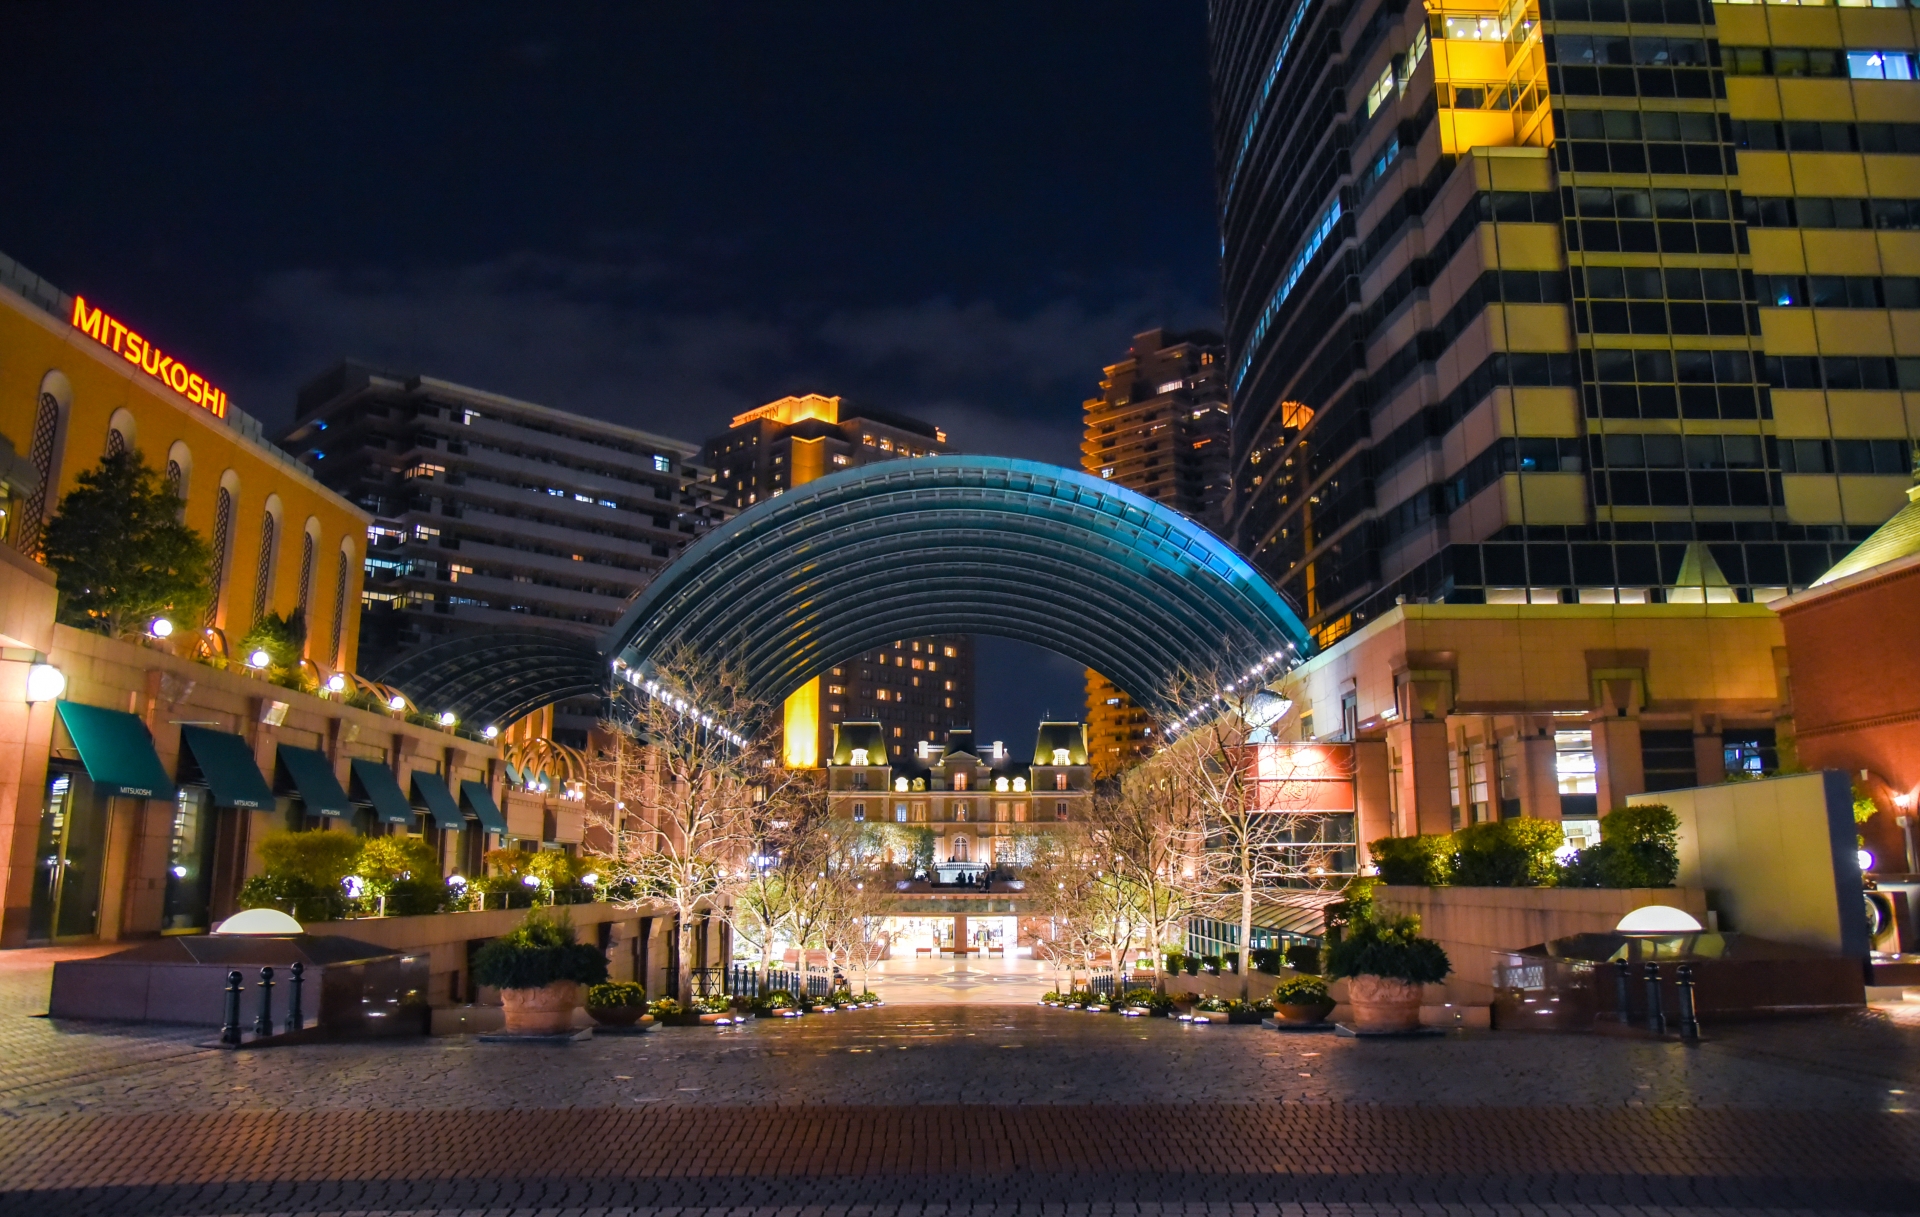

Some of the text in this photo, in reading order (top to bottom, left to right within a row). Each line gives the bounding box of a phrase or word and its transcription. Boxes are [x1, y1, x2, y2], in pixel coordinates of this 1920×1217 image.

[73, 295, 226, 419] MITSUKOSHI
[120, 786, 152, 796] MITSUKOSHI
[234, 799, 258, 808] MITSUKOSHI
